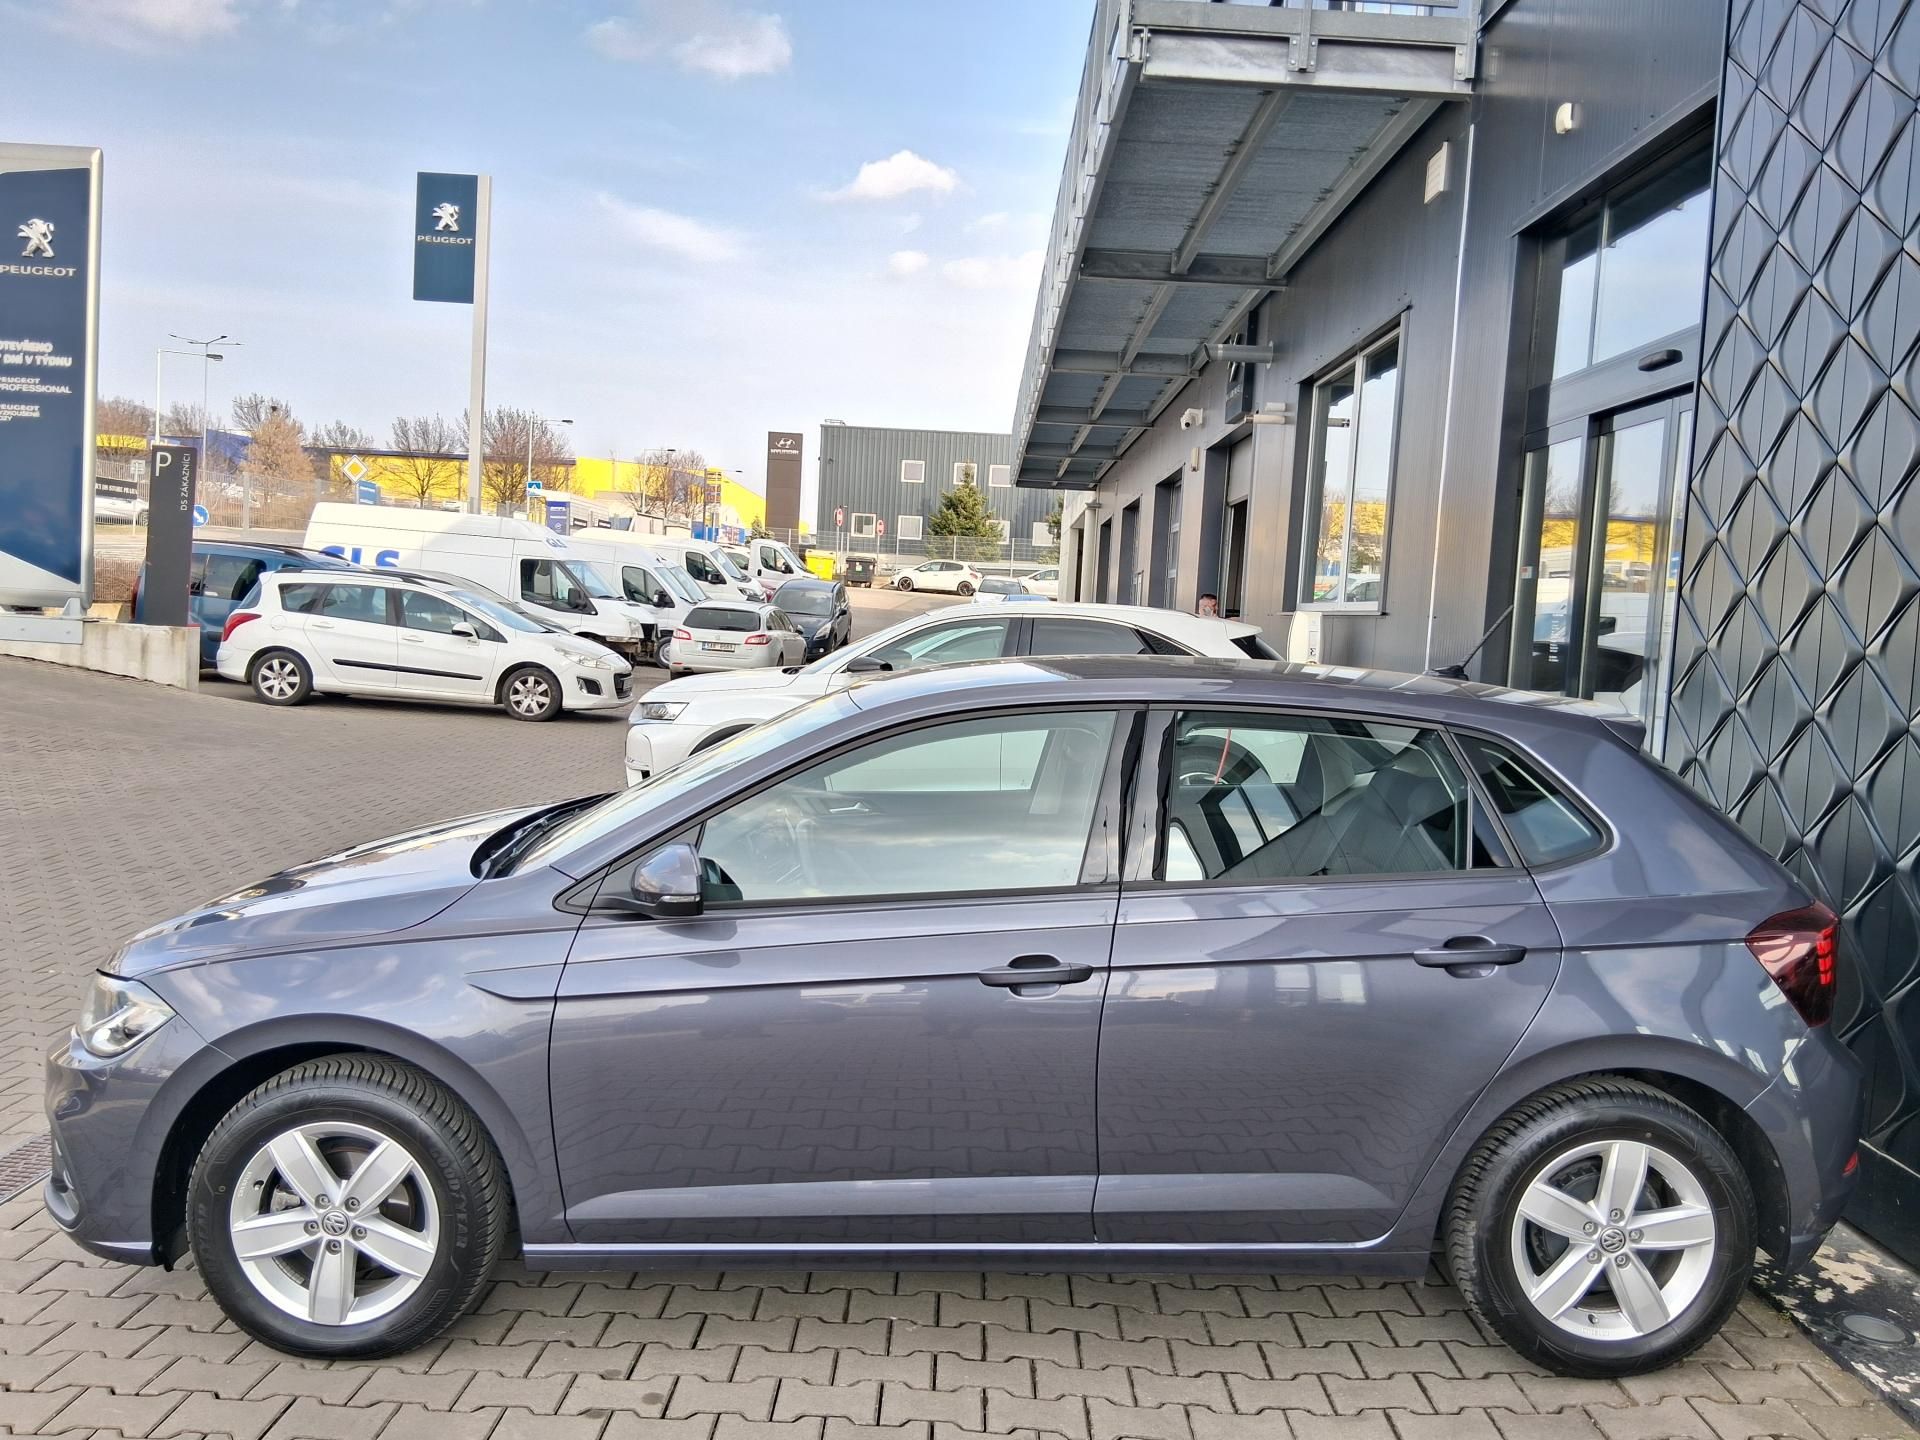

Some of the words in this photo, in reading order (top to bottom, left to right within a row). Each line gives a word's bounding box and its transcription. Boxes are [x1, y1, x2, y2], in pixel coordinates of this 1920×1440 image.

[417, 235, 473, 244] PEUGEOT
[0, 265, 77, 276] PEUGEOT
[25, 355, 34, 365] V
[155, 452, 172, 477] P
[180, 453, 191, 499] ZÁKAZNÍCI
[180, 500, 188, 511] DS
